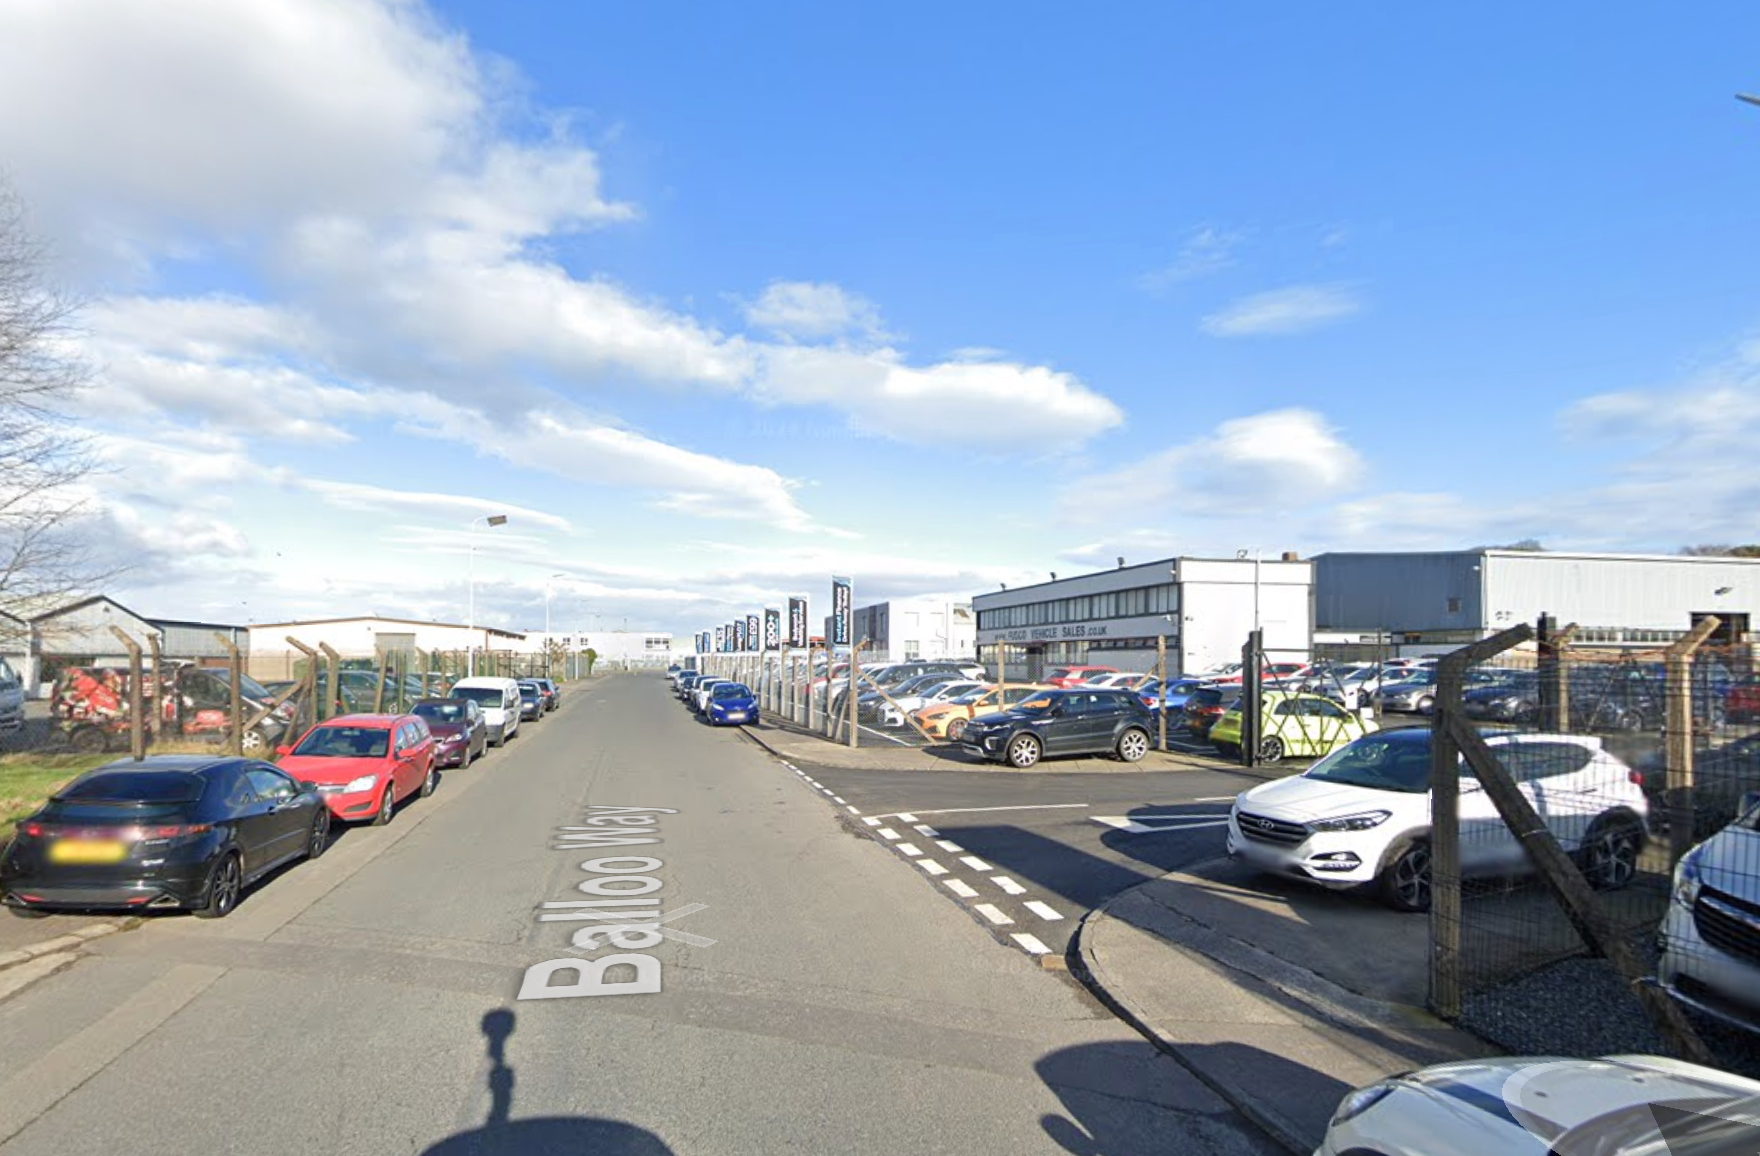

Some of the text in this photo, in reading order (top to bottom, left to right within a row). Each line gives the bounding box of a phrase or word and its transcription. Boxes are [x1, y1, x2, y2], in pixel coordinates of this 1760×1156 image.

[766, 614, 775, 647] 200+
[1030, 627, 1057, 638] VEHICLE
[1062, 625, 1085, 637] SALES
